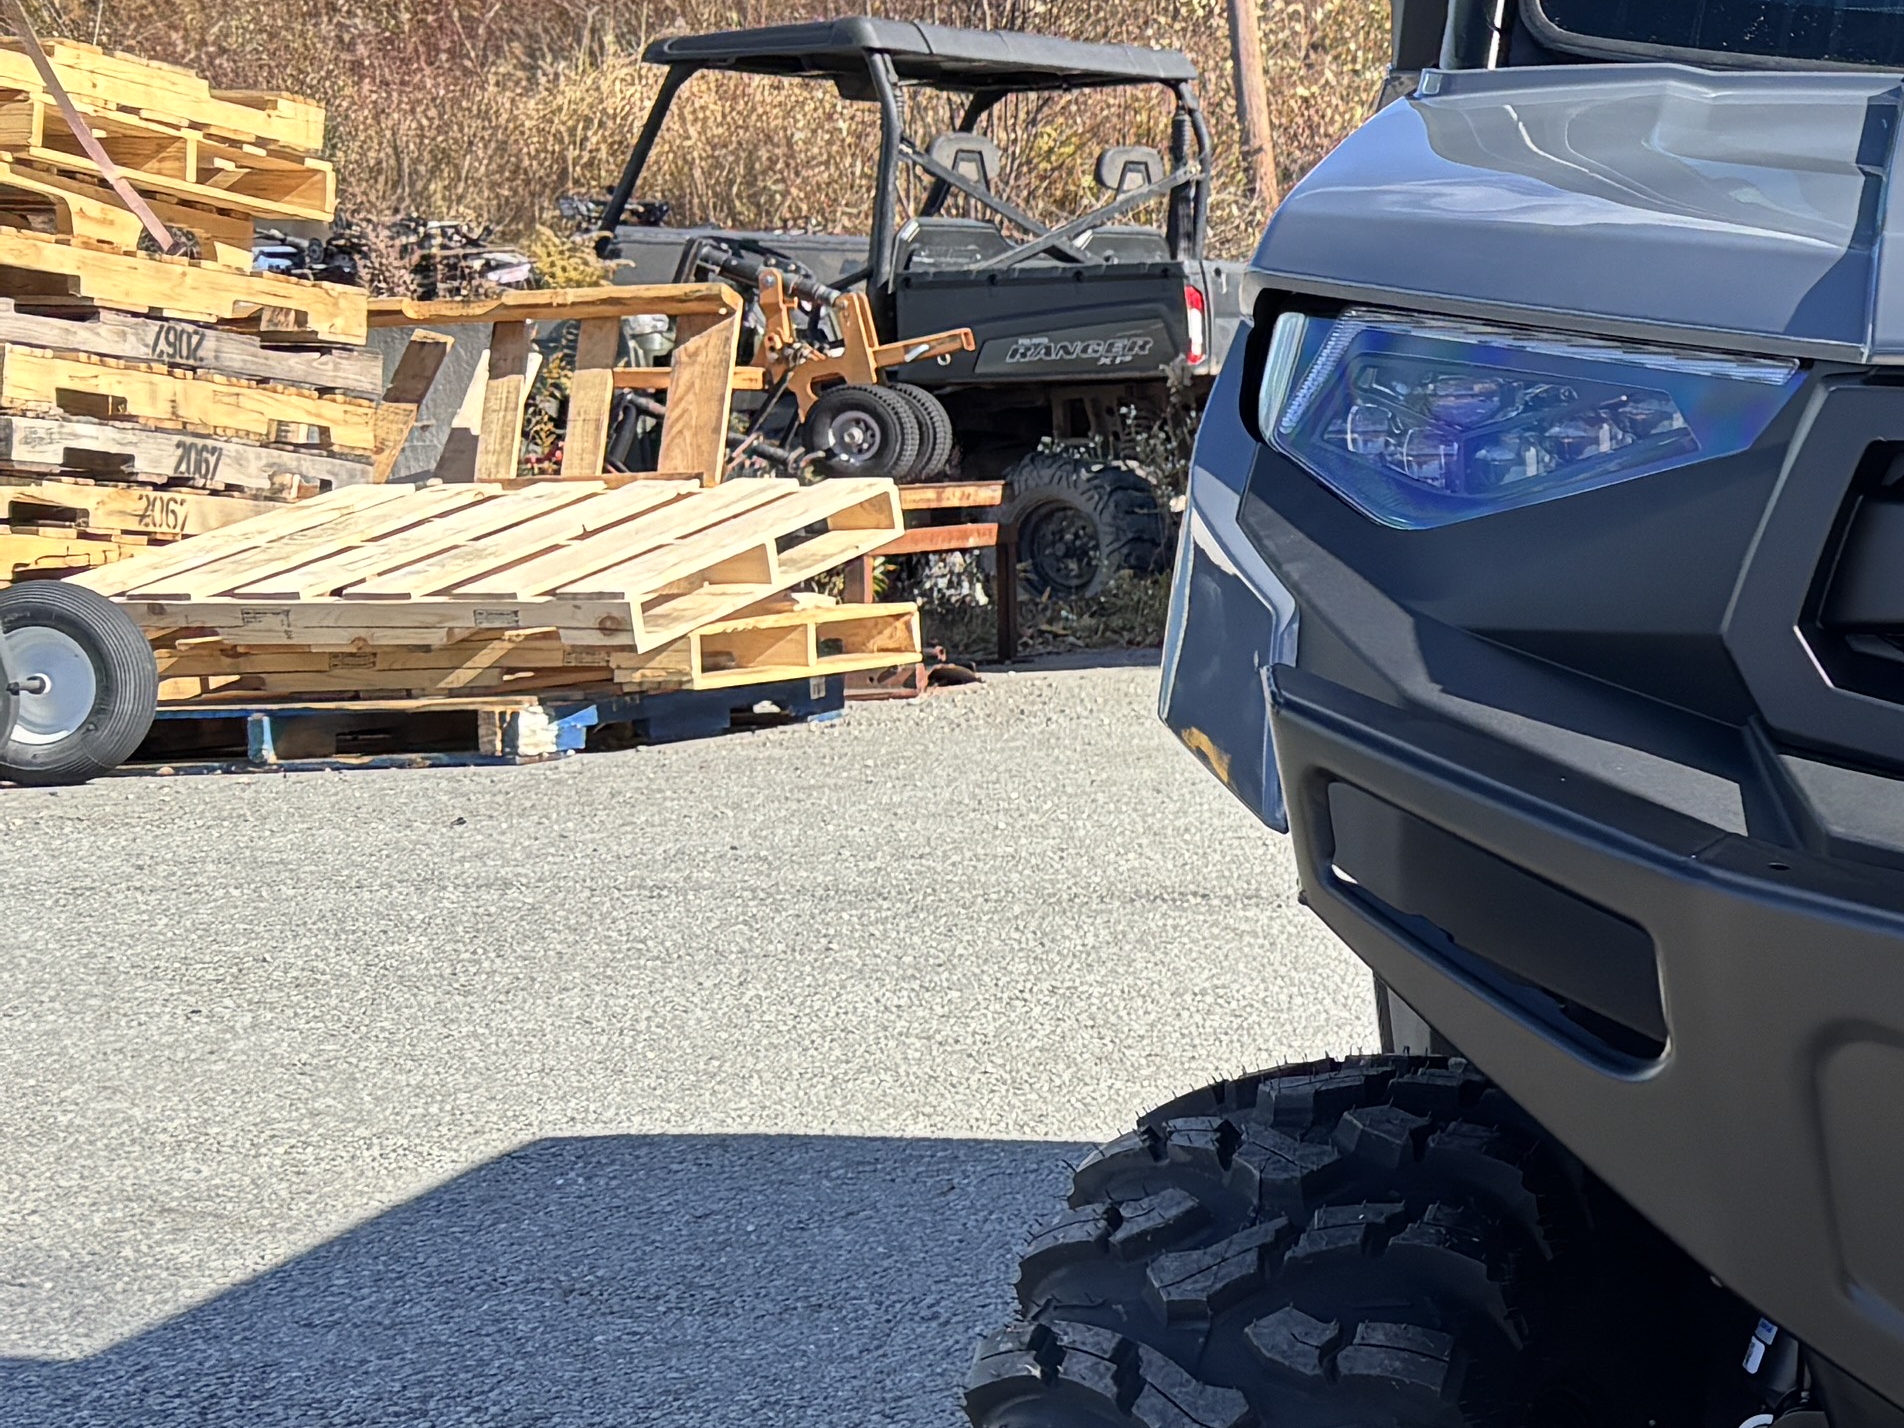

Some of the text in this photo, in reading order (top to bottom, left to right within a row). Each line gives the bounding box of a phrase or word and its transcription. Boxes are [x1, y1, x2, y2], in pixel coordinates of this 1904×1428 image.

[1006, 337, 1154, 364] RANGER
[175, 439, 223, 481] 2067
[138, 493, 189, 531] 2067
